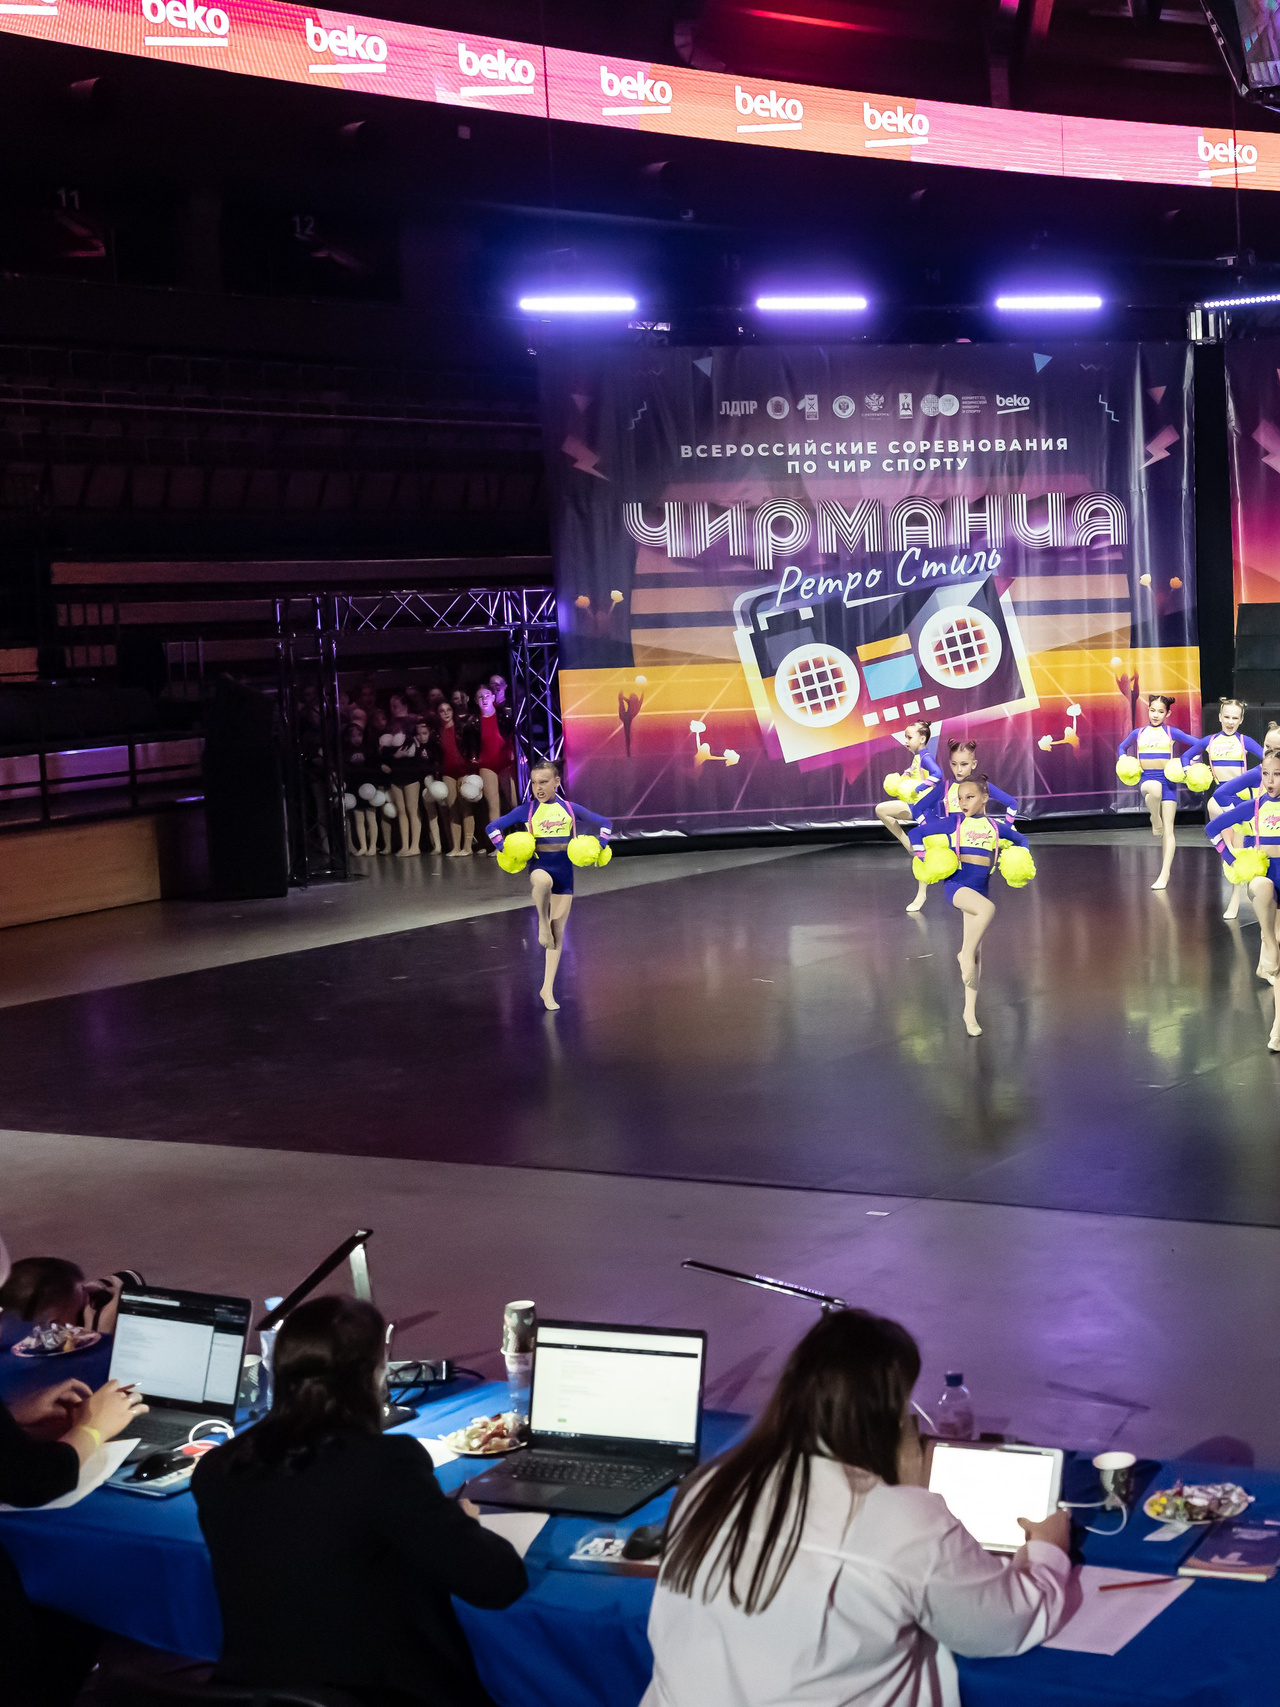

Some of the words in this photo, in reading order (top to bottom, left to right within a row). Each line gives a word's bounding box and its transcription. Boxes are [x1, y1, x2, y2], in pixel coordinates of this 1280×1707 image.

[143, 0, 230, 36] beko
[305, 18, 387, 63] beko
[457, 43, 535, 84] beko
[600, 66, 672, 104] beko
[735, 85, 803, 122] beko
[864, 102, 929, 136] beko
[1198, 136, 1258, 164] beko
[720, 400, 758, 417] ЛДПР
[996, 394, 1030, 407] beko
[680, 439, 878, 458] ВСЕРОССИЙСКИЕ
[888, 438, 1069, 454] СОРЕВНОВАНИЯ
[787, 460, 818, 474] ПО
[828, 458, 872, 472] ЧИР
[882, 458, 969, 472] СПОРТУ
[777, 566, 882, 607] Ретро
[897, 547, 1001, 587] Стиль
